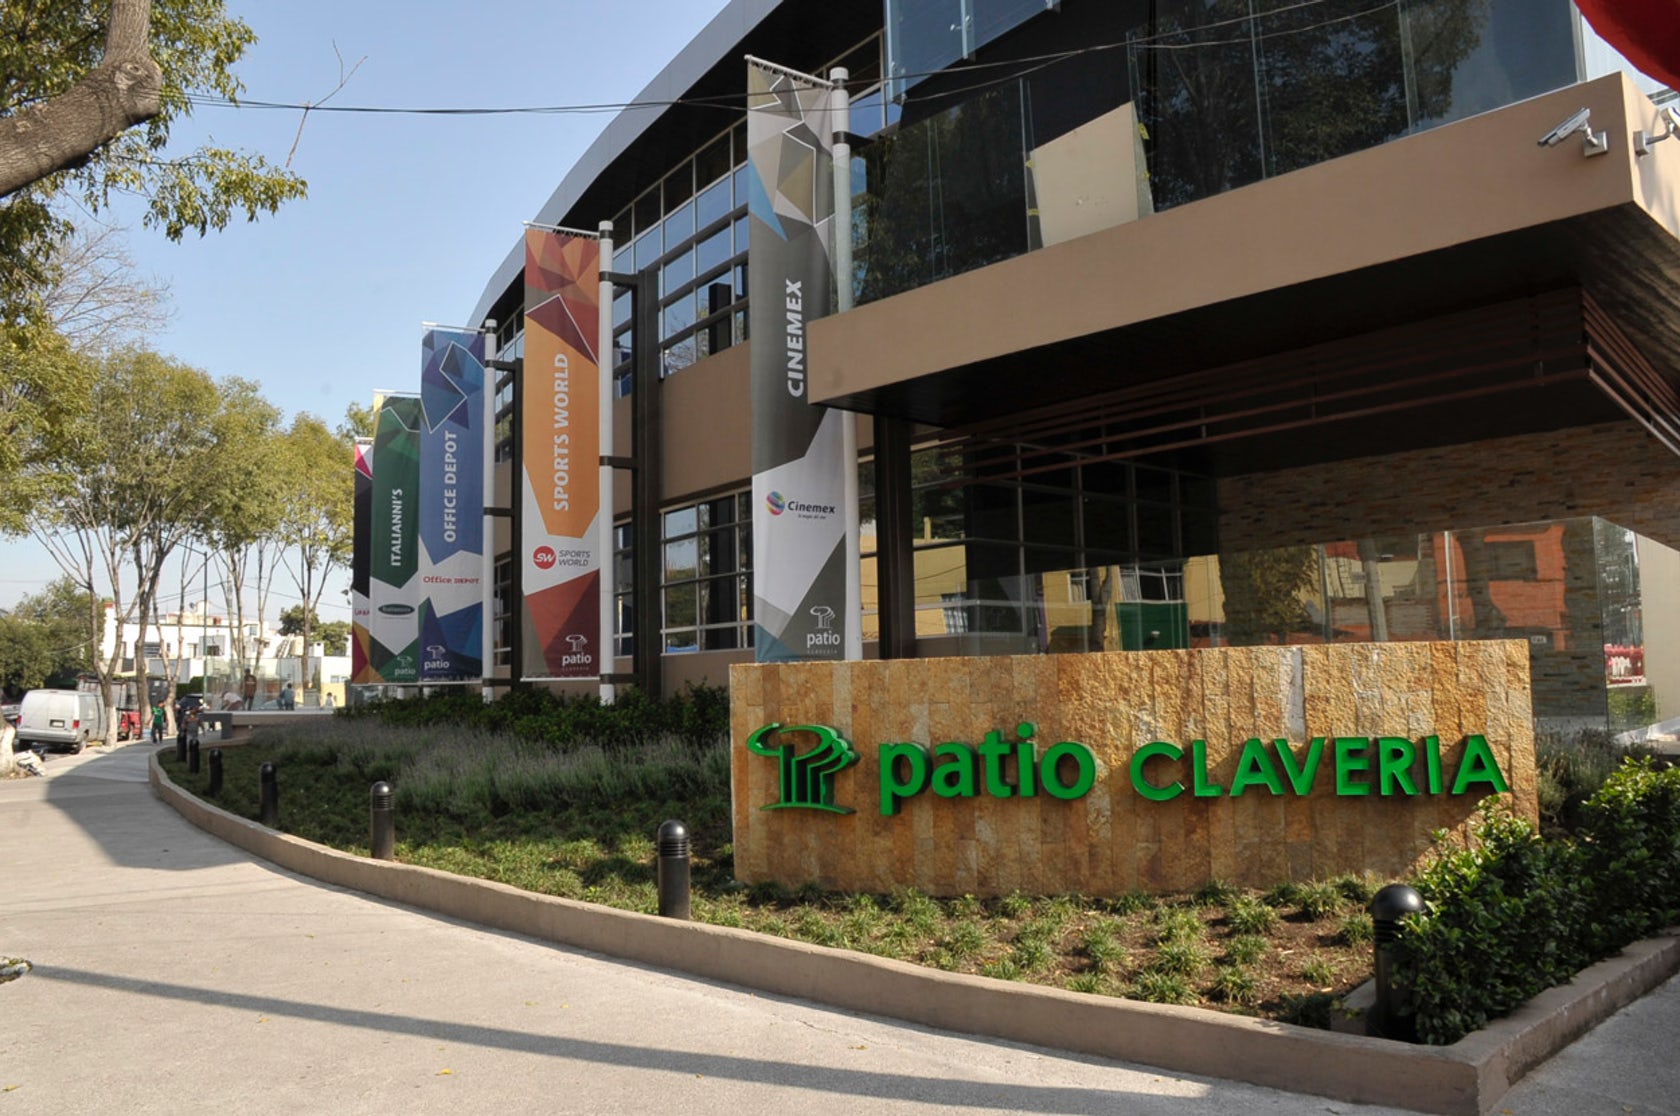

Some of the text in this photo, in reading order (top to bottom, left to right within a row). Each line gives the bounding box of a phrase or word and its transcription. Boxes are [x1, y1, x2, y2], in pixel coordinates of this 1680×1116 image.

[785, 278, 804, 398] CINEMEX
[553, 353, 569, 512] SPORTS WORLD
[443, 430, 457, 543] OFFICE DEPOT
[787, 500, 836, 514] Cinemex
[559, 549, 591, 559] SPORTS
[559, 559, 589, 567] WORLD
[422, 575, 452, 585] Office
[453, 577, 480, 585] DEPOT
[562, 630, 841, 667] patio patio
[424, 659, 450, 671] patio
[879, 721, 1510, 816] patio CLAVERIA
